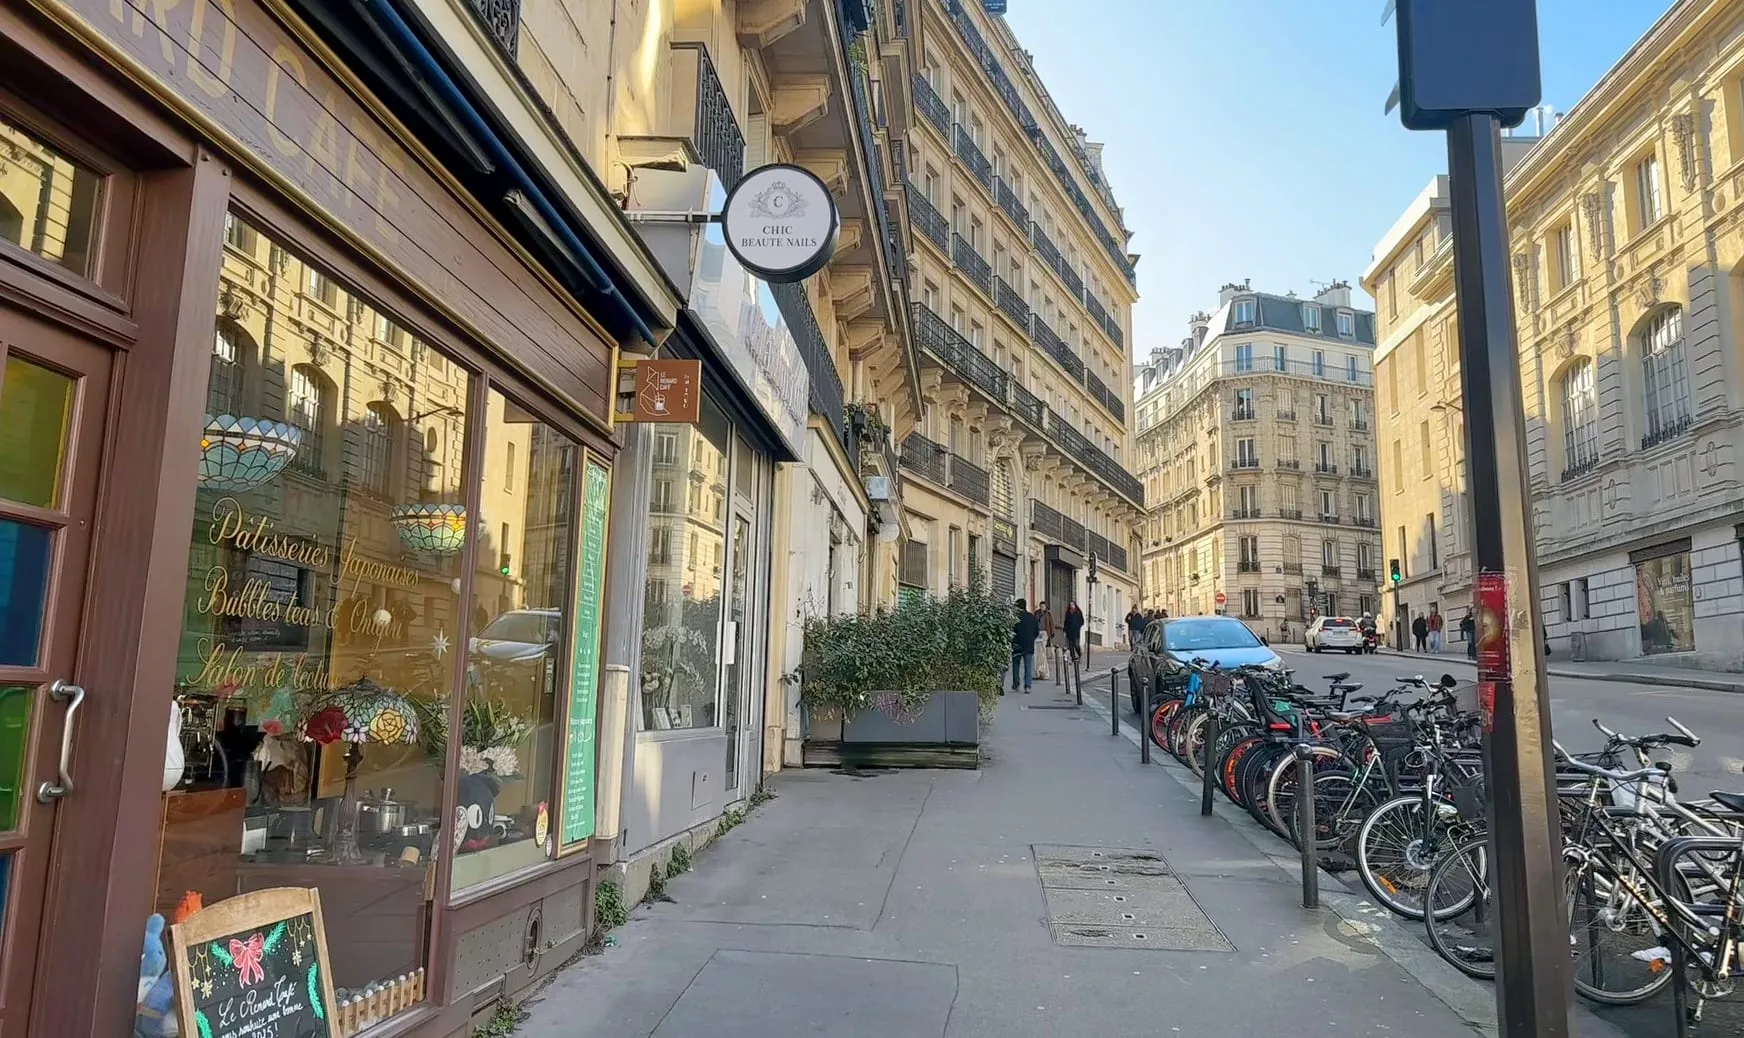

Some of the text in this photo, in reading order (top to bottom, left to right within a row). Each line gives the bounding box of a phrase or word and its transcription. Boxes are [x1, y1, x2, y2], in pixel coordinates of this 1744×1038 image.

[773, 195, 784, 208] C
[762, 225, 793, 235] CHIC
[741, 238, 817, 247] BEAUTE NAILS
[197, 565, 280, 622] Bubbles
[284, 589, 320, 627] teas
[186, 637, 257, 690] Salon
[264, 652, 285, 688] de
[219, 997, 237, 1028] Le
